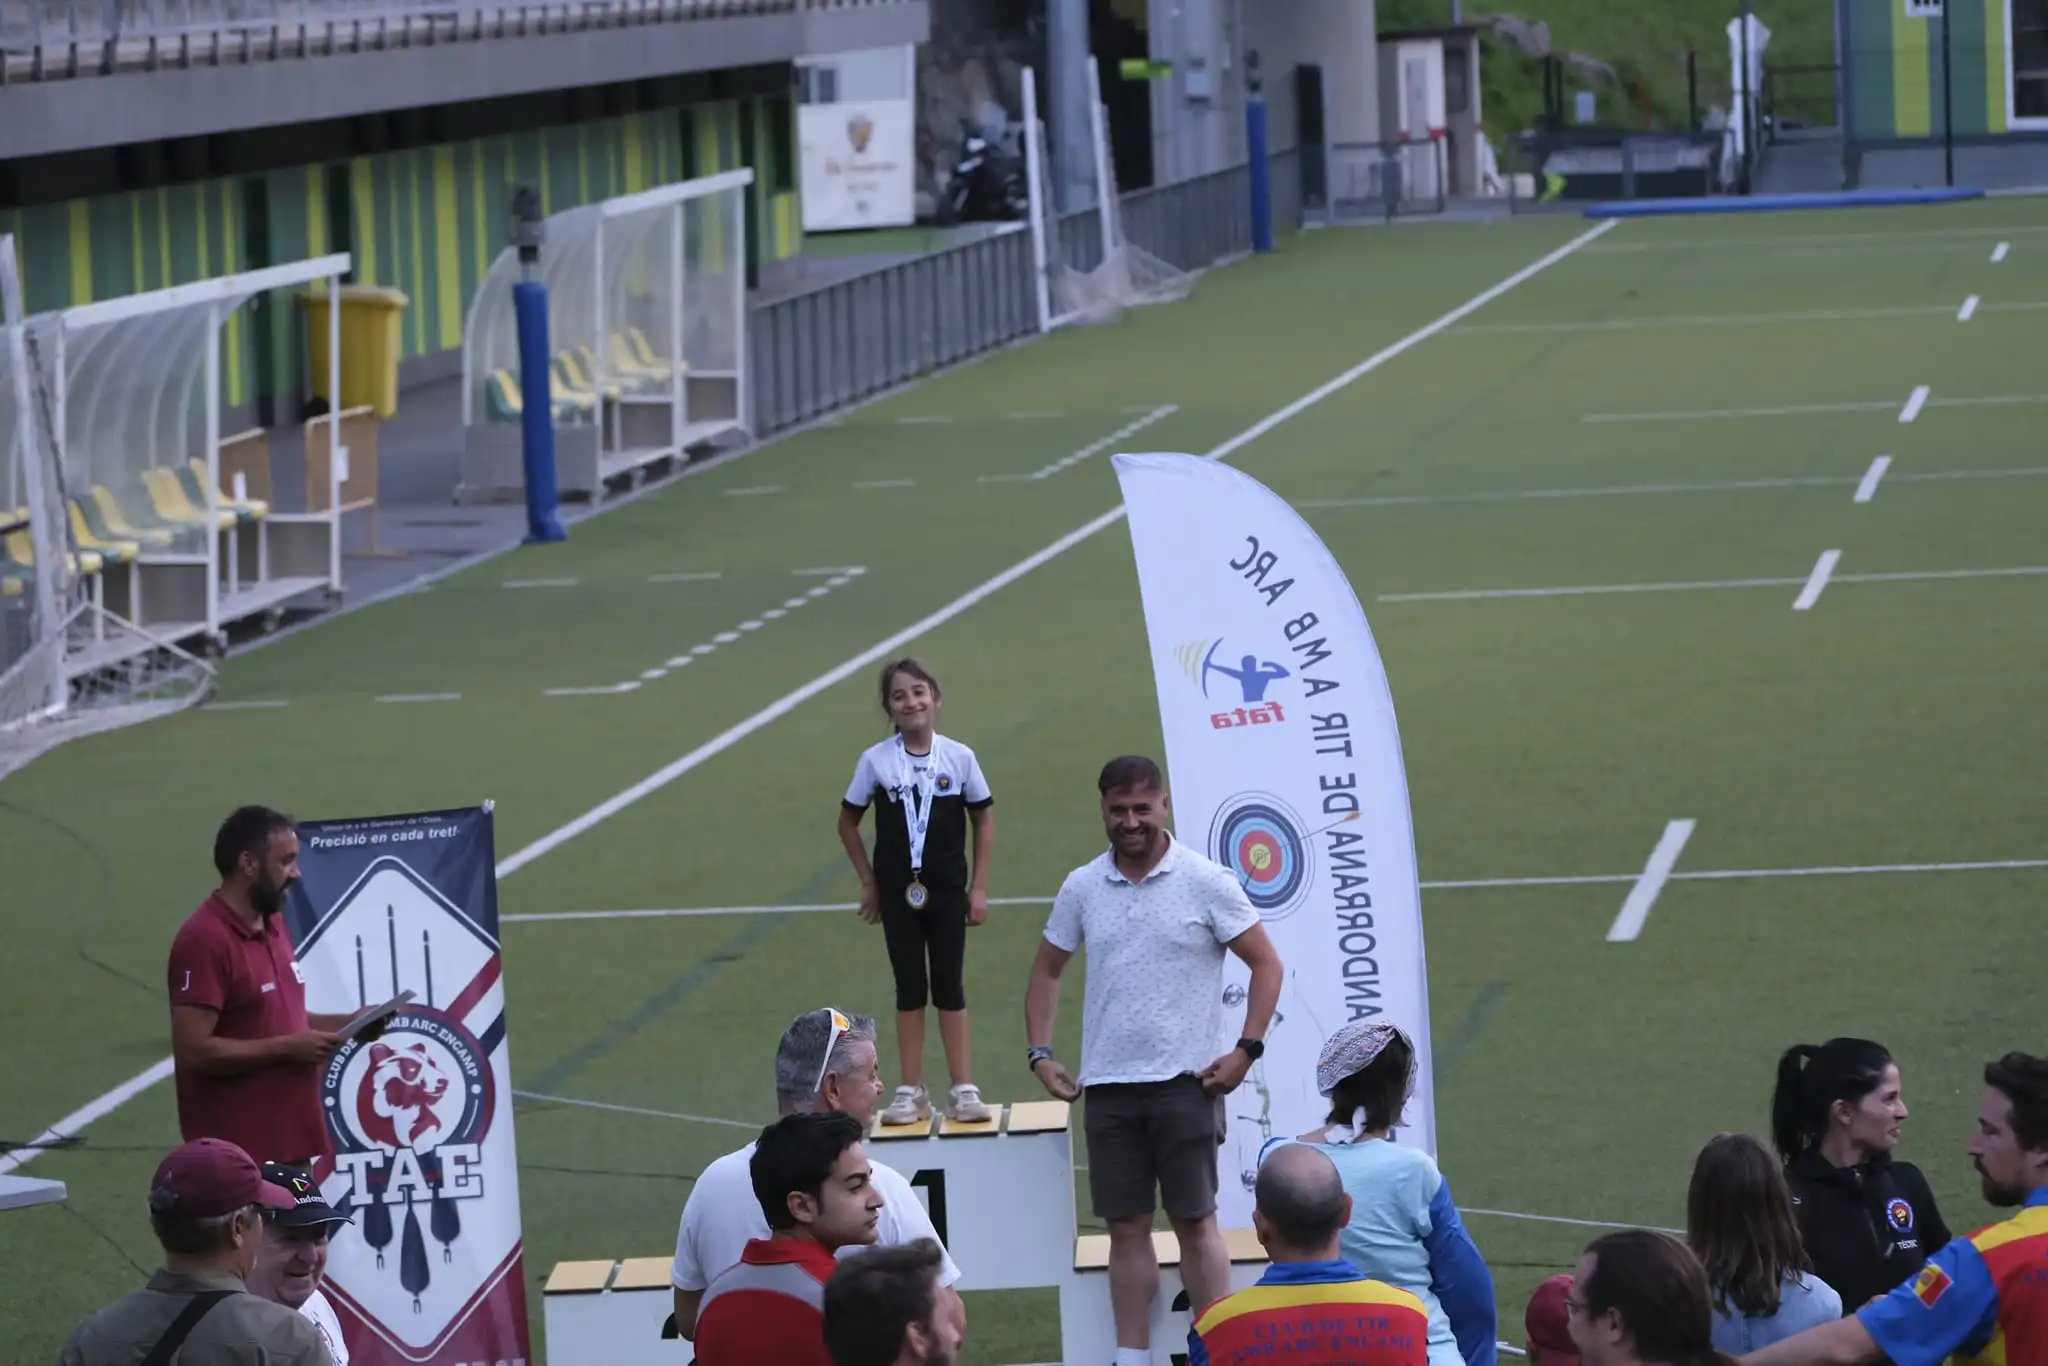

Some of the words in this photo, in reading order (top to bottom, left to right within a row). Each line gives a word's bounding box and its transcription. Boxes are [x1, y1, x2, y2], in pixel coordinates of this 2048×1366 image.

[311, 835, 366, 849] Precisió
[371, 833, 387, 843] en
[392, 830, 424, 842] cada
[428, 826, 458, 839] tret!
[326, 1054, 346, 1089] CLUB
[341, 1038, 358, 1054] DE
[386, 1016, 409, 1029] MB
[411, 1018, 438, 1033] ARC
[437, 1028, 478, 1077] ENCAMP
[335, 1142, 484, 1207] TAE
